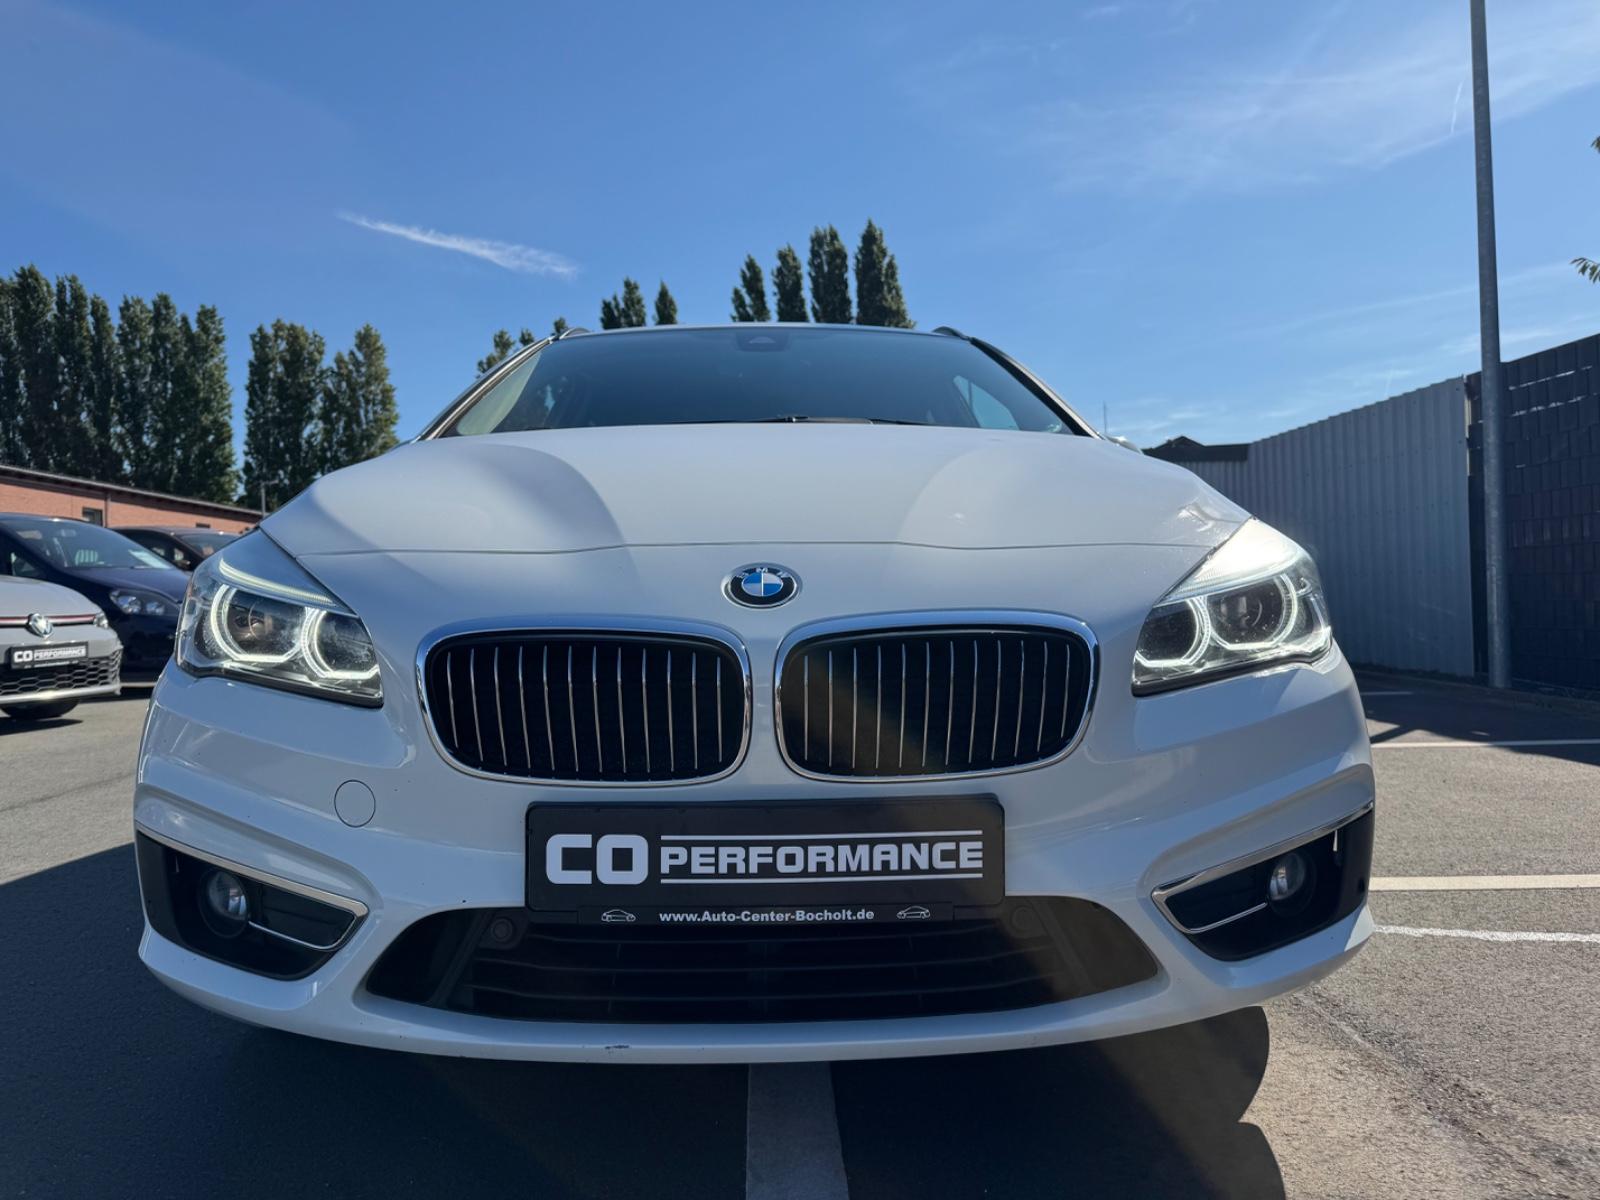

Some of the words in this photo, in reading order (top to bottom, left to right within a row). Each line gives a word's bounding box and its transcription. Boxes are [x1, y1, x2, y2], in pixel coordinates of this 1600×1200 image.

[14, 650, 33, 663] CO
[546, 833, 649, 885] CO
[660, 841, 983, 874] PERFORMANCE
[659, 908, 875, 923] www.Auto-Center-Bocholt.de
